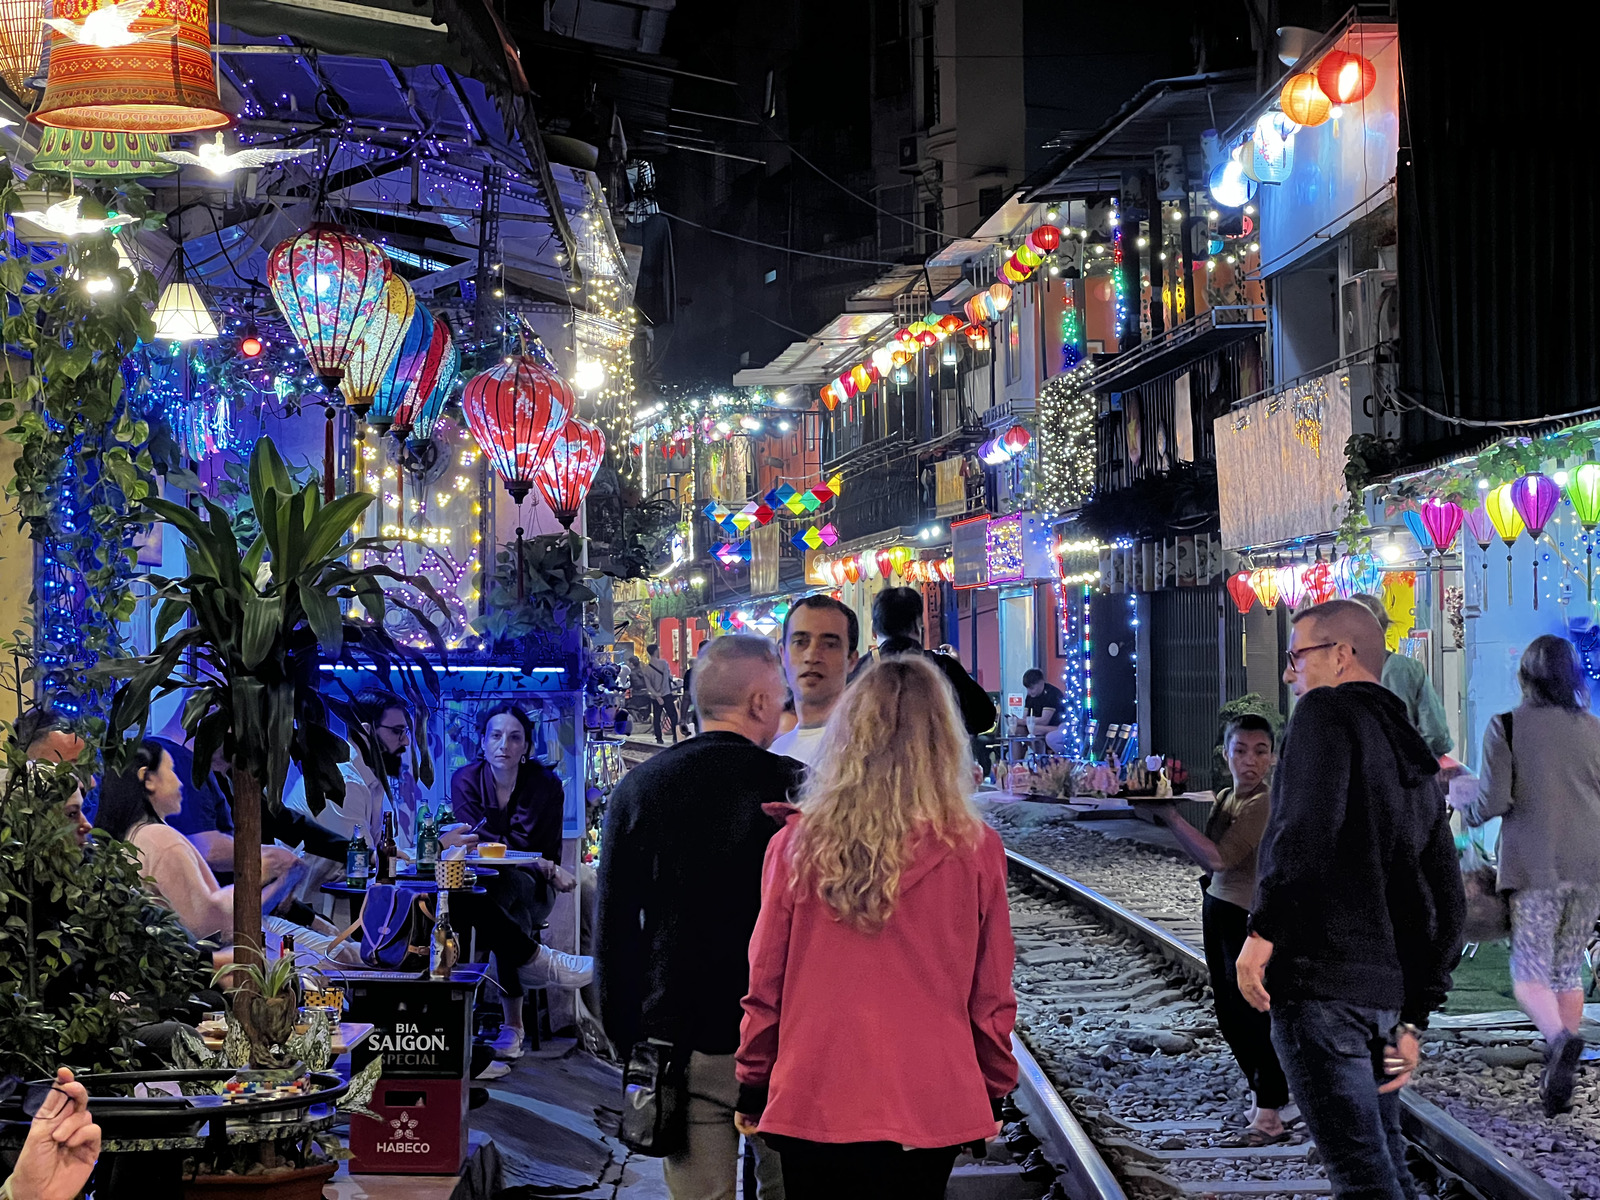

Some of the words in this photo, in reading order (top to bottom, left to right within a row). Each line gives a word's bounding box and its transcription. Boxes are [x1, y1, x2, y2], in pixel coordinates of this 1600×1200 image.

[395, 1023, 419, 1034] BIA
[377, 1053, 439, 1066] SPECIAL
[376, 1142, 431, 1154] HABECO
